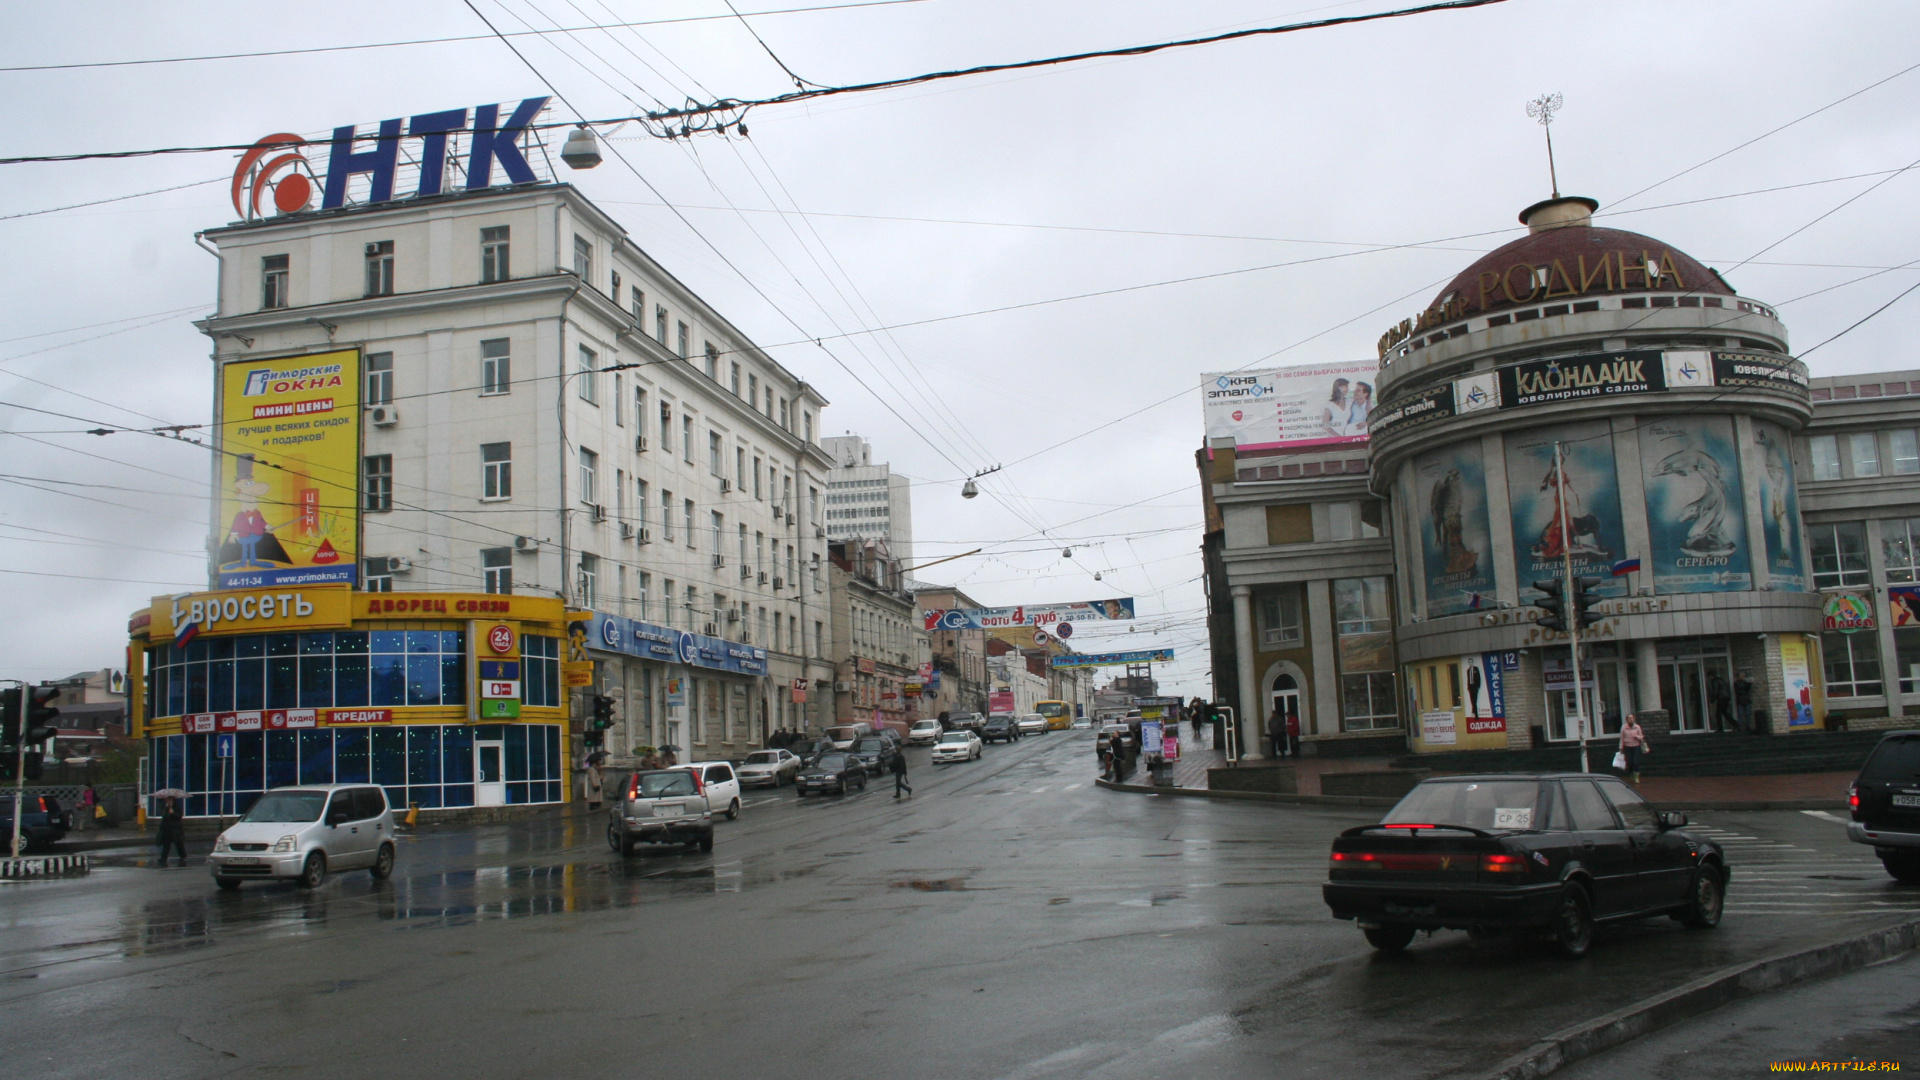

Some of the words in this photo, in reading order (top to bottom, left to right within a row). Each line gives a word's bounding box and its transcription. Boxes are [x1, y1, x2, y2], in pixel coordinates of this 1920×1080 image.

[321, 96, 552, 210] НТК
[1478, 249, 1684, 312] РОДИНА
[1293, 369, 1313, 377] СЕМЕЙ
[1313, 368, 1341, 376] ВЫБРАЛИ
[1516, 356, 1647, 396] КЛОНДАЙК
[273, 375, 342, 393] ОКНА
[1518, 387, 1600, 405] ювелирный
[1605, 383, 1648, 394] салон
[254, 404, 293, 417] МИНИ
[296, 399, 333, 414] ЦЕНЫ
[237, 425, 272, 437] лучше
[275, 421, 310, 432] всяких
[313, 416, 349, 427] скидок
[272, 431, 325, 446] подарков!
[1531, 558, 1589, 571] ПРЕДМТЫ
[1676, 556, 1728, 567] СЕРЕБРО
[1552, 564, 1611, 577] ИНЕРЬЕРА
[227, 576, 262, 587] 44-11-34
[275, 571, 349, 585] www.primokna.ru
[368, 598, 447, 614] ДВОРЕЦ
[455, 599, 511, 613] СВЯЗИ
[981, 616, 1010, 627] ФОТО
[494, 631, 510, 642] 24
[1504, 652, 1516, 665] 12
[1490, 655, 1502, 715] МУЖСКАЯ
[237, 717, 259, 725] ФОТО
[287, 714, 315, 722] АУДИО
[333, 711, 385, 722] КРЕДИТ
[1470, 720, 1503, 731] ОДЕЖДА
[1517, 814, 1529, 823] 25
